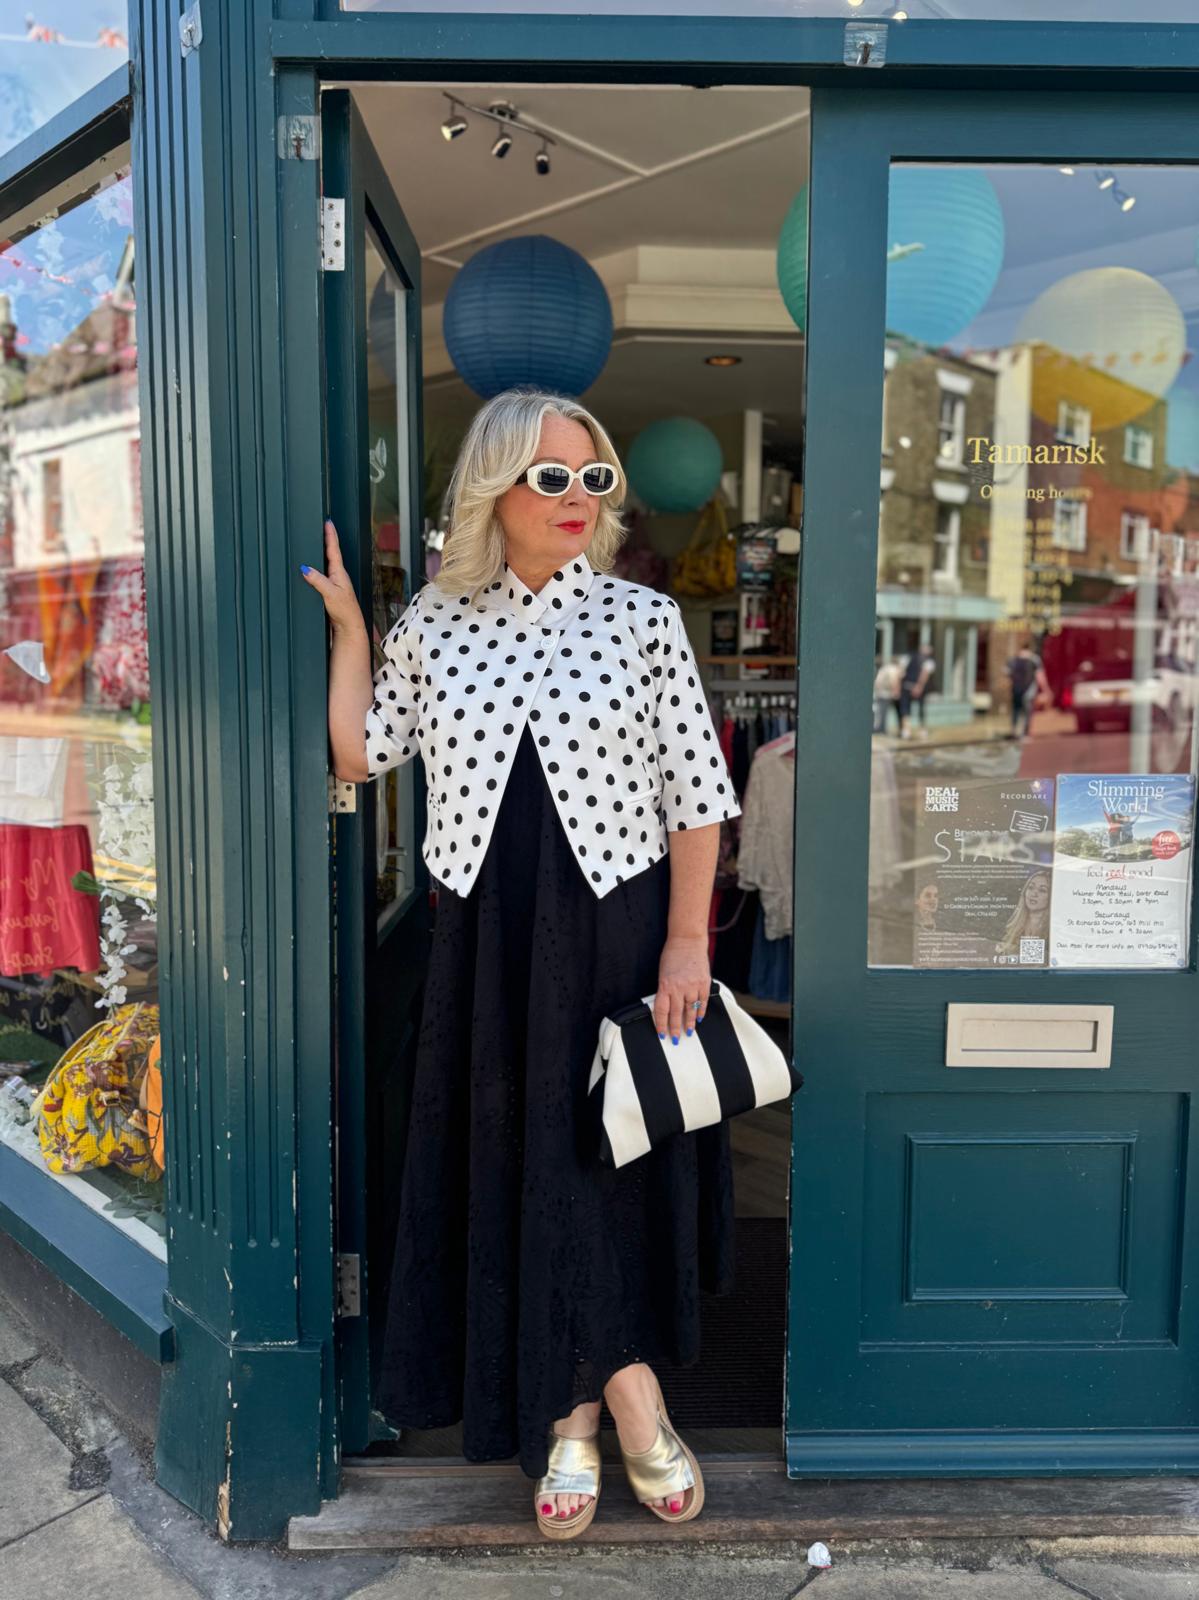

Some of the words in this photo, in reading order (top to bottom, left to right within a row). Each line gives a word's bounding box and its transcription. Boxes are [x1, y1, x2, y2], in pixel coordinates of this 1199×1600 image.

[967, 436, 1104, 465] Tamarisk
[925, 786, 960, 797] DEAL
[1087, 779, 1165, 800] Slimming
[925, 796, 959, 804] MUSIC
[1102, 797, 1149, 813] World
